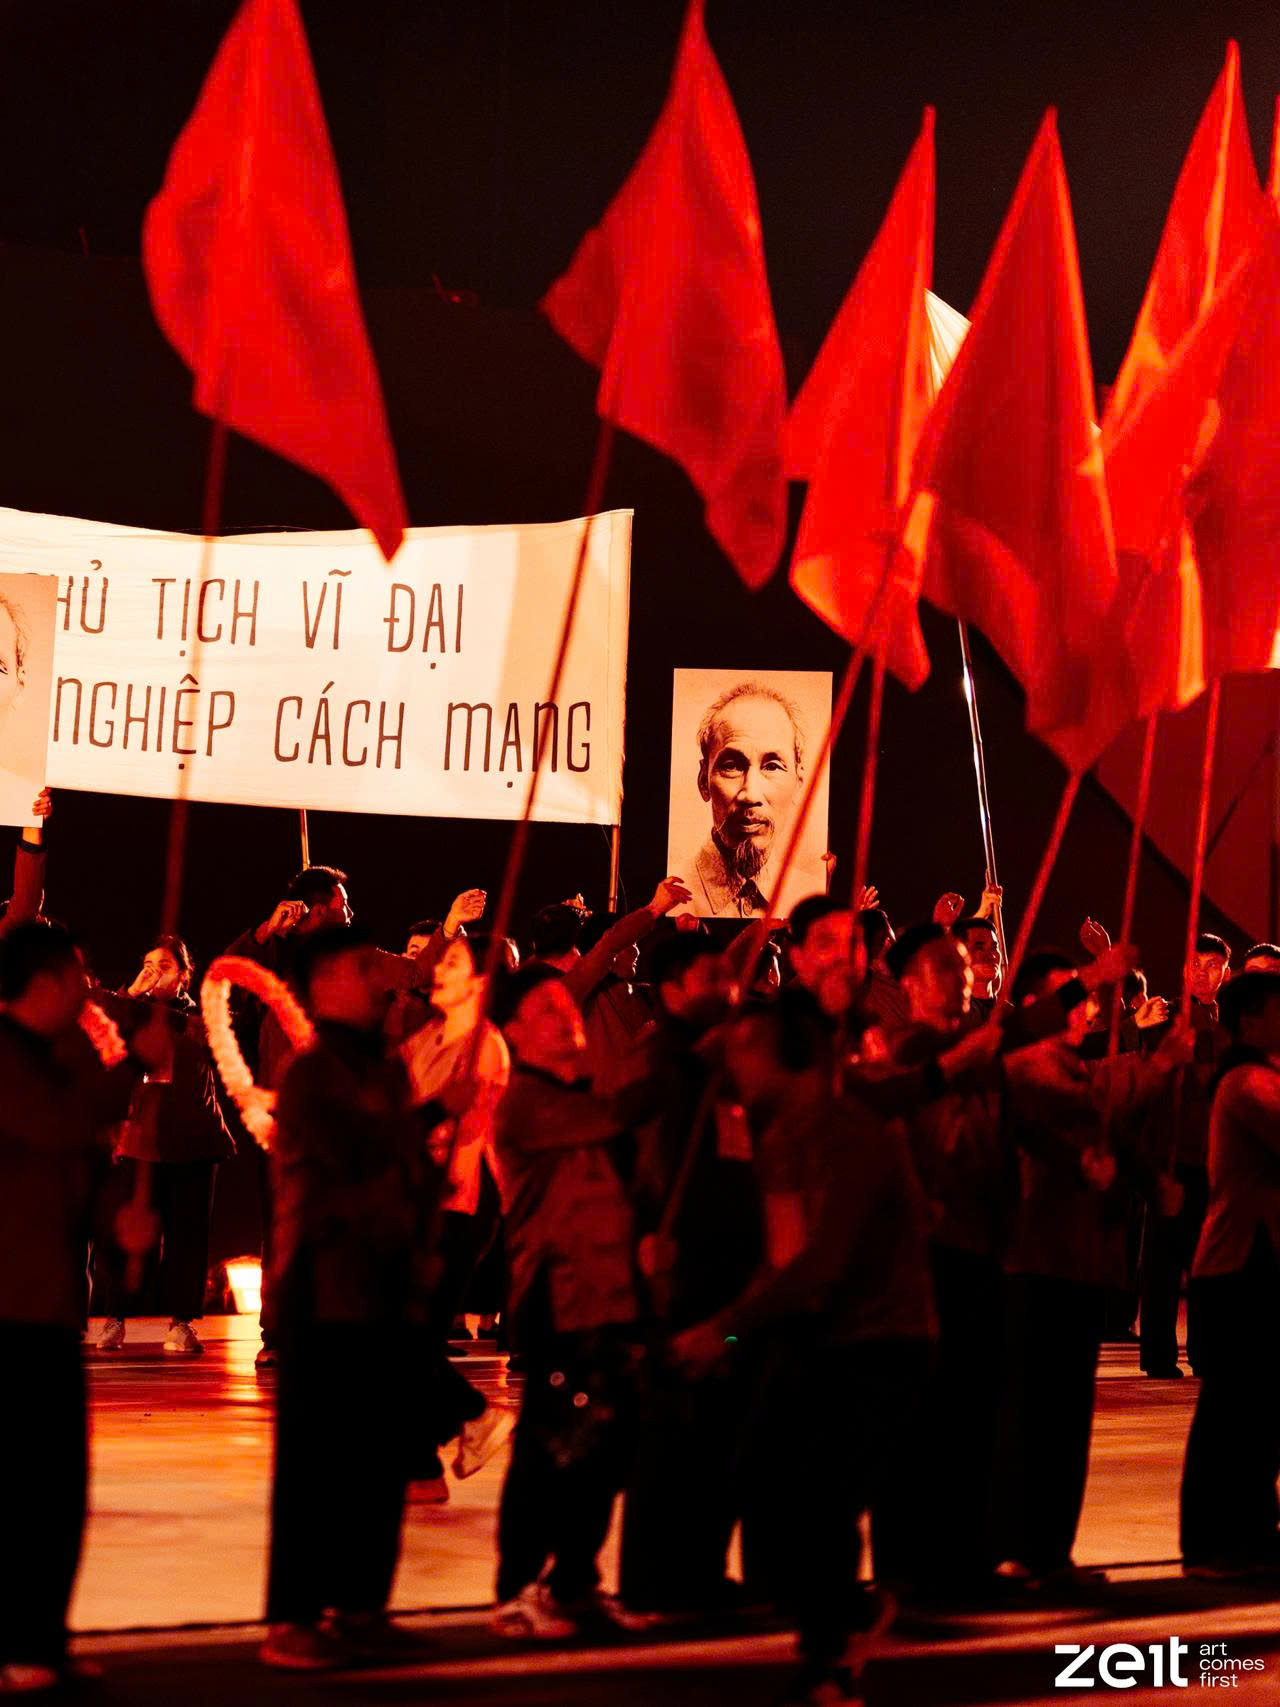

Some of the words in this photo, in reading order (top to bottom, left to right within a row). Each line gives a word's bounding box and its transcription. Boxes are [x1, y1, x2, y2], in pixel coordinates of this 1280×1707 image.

[24, 558, 110, 634] HỦ
[152, 578, 259, 656] TỊCH
[302, 568, 352, 650] VĨ
[383, 583, 464, 669] ĐẠI
[274, 681, 405, 769] CÁCH
